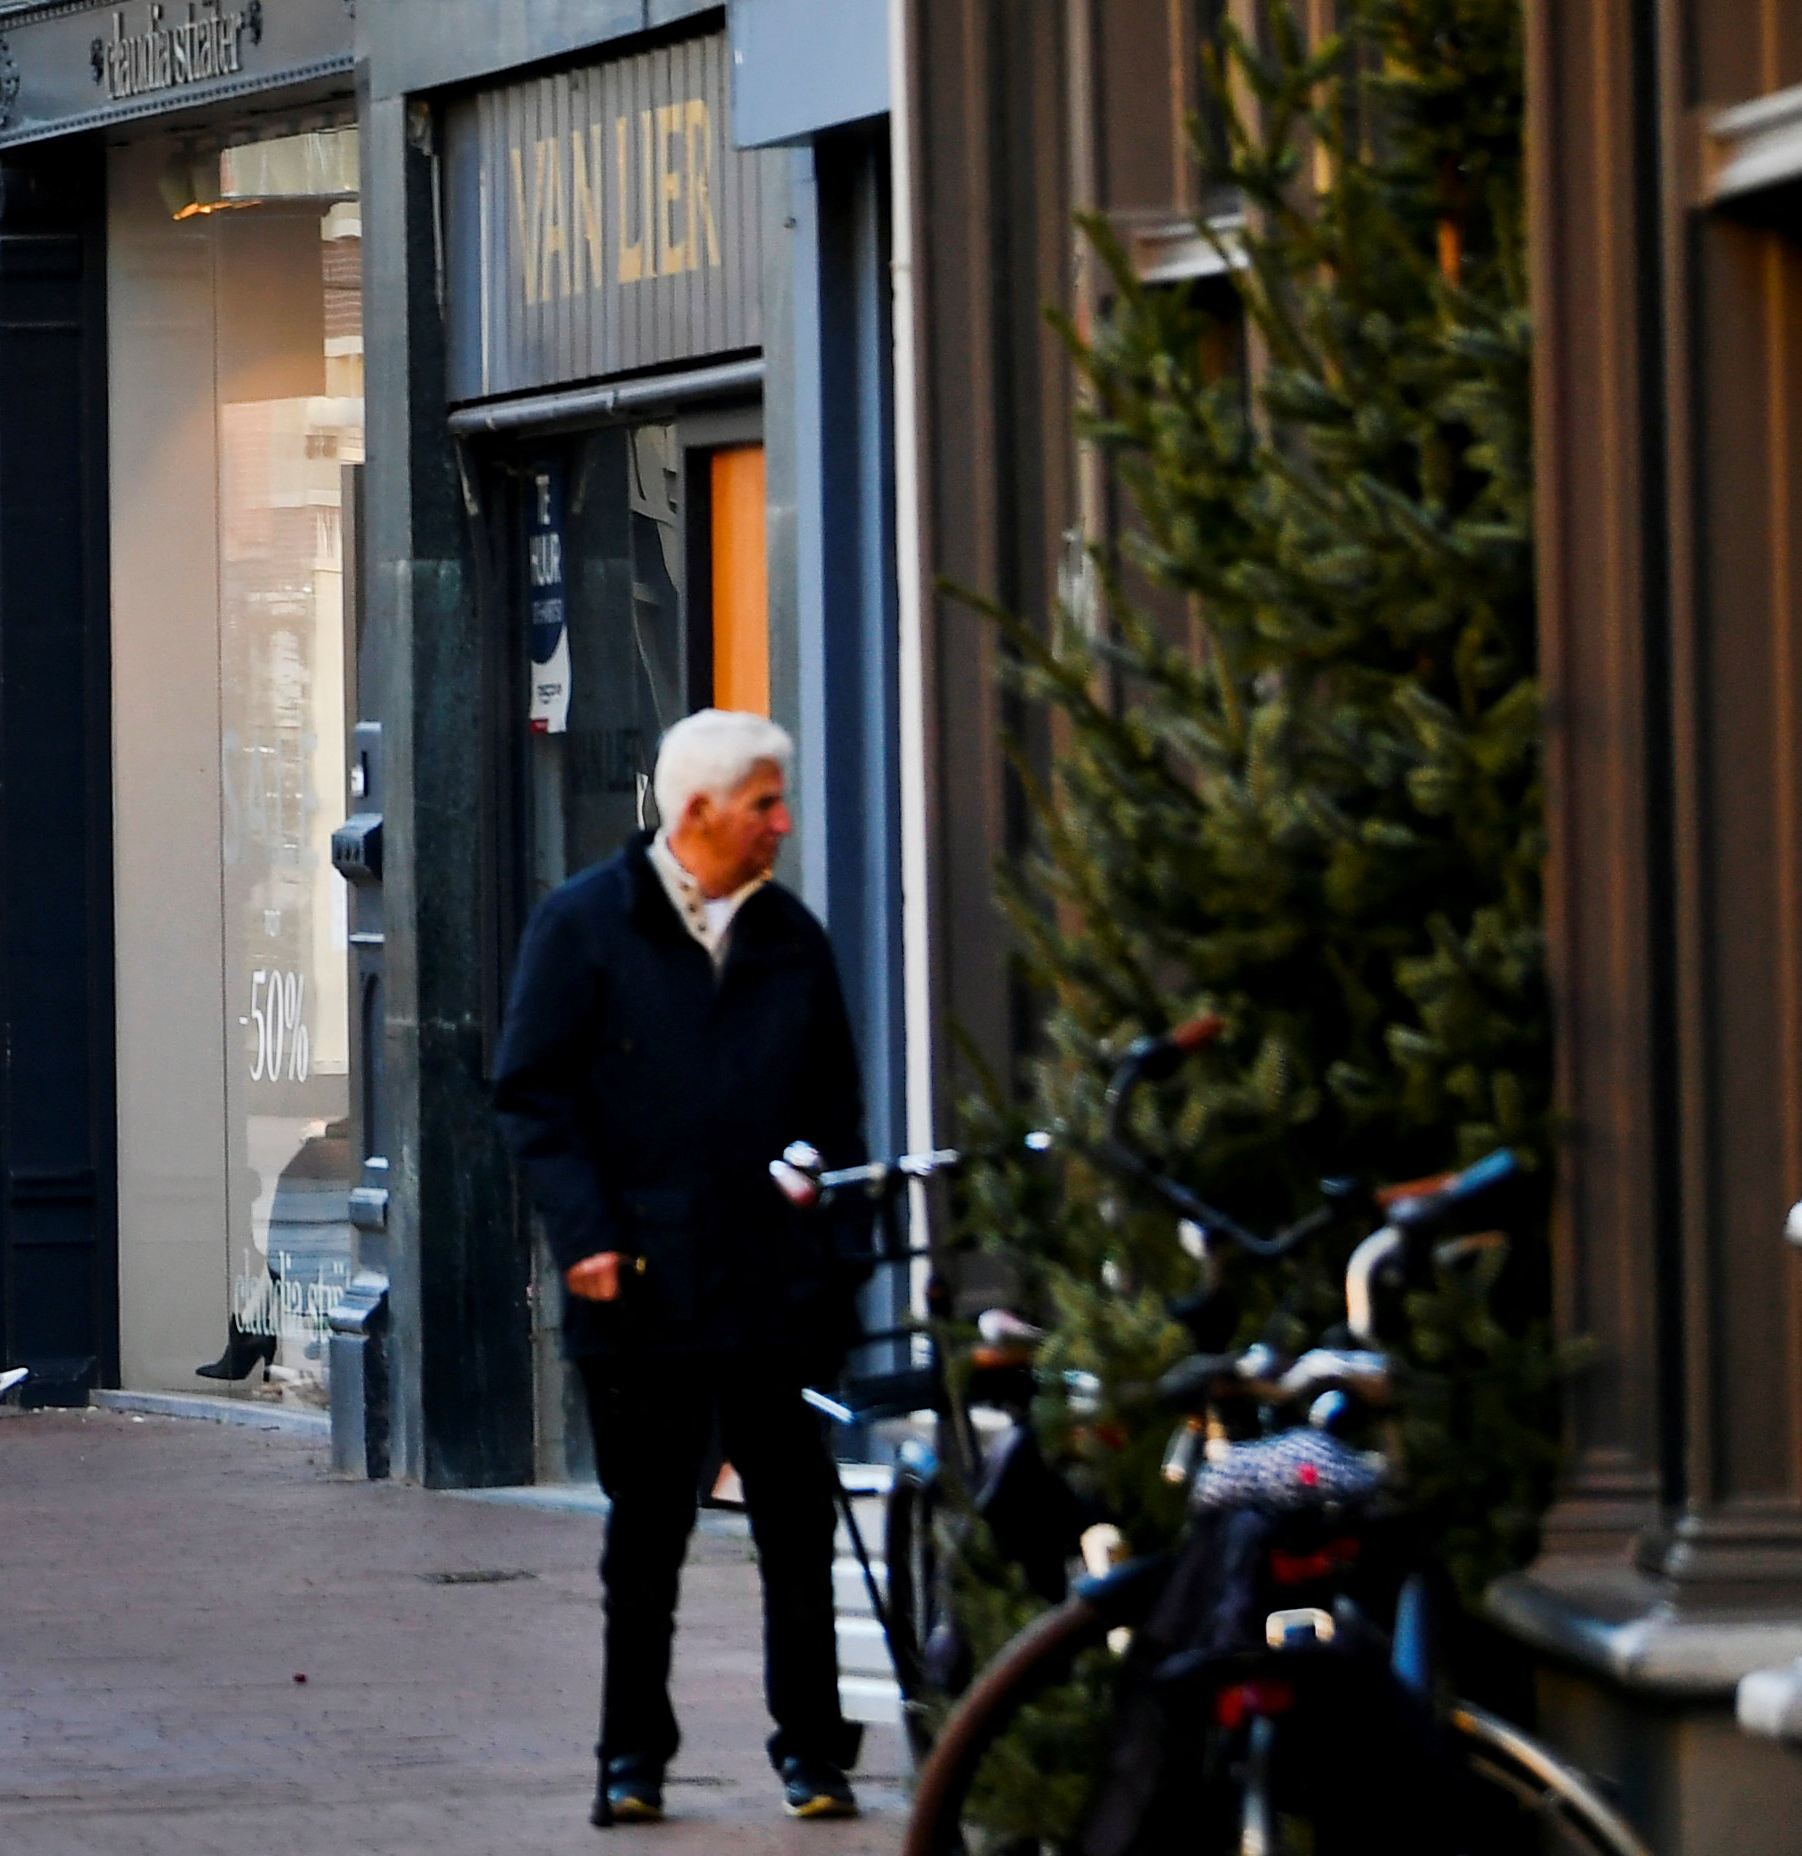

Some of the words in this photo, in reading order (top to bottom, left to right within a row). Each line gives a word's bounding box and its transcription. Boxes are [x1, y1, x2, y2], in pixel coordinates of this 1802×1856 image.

[510, 122, 604, 307] VAN
[615, 97, 722, 286] LIER
[238, 968, 309, 1083] -50%
